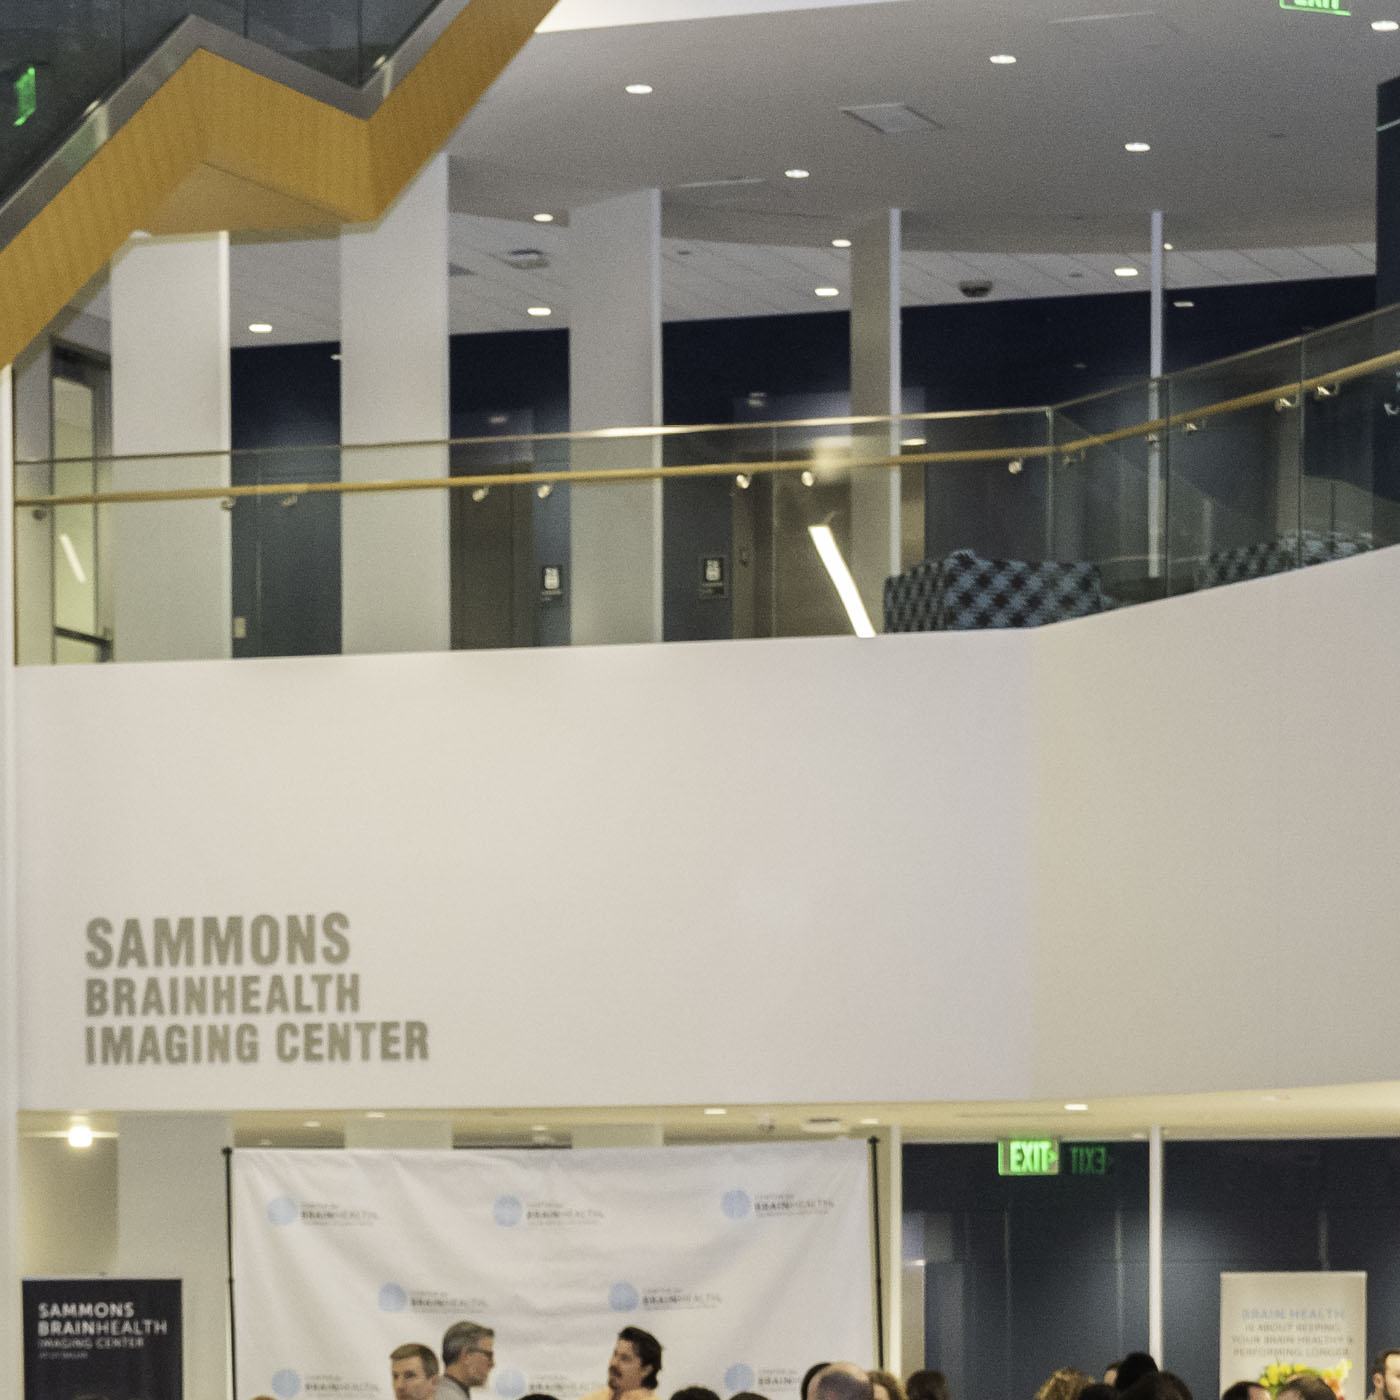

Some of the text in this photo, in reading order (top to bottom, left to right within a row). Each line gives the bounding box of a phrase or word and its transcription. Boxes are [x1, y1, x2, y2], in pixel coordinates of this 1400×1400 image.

[85, 912, 351, 969] SAMMONS
[85, 973, 360, 1017] BRAINHEALTH
[85, 1020, 430, 1064] IMAGING CENTER
[1010, 1140, 1051, 1173] EXIT
[38, 1302, 135, 1319] SAMMONS
[38, 1319, 168, 1337] BRAINHEALTH
